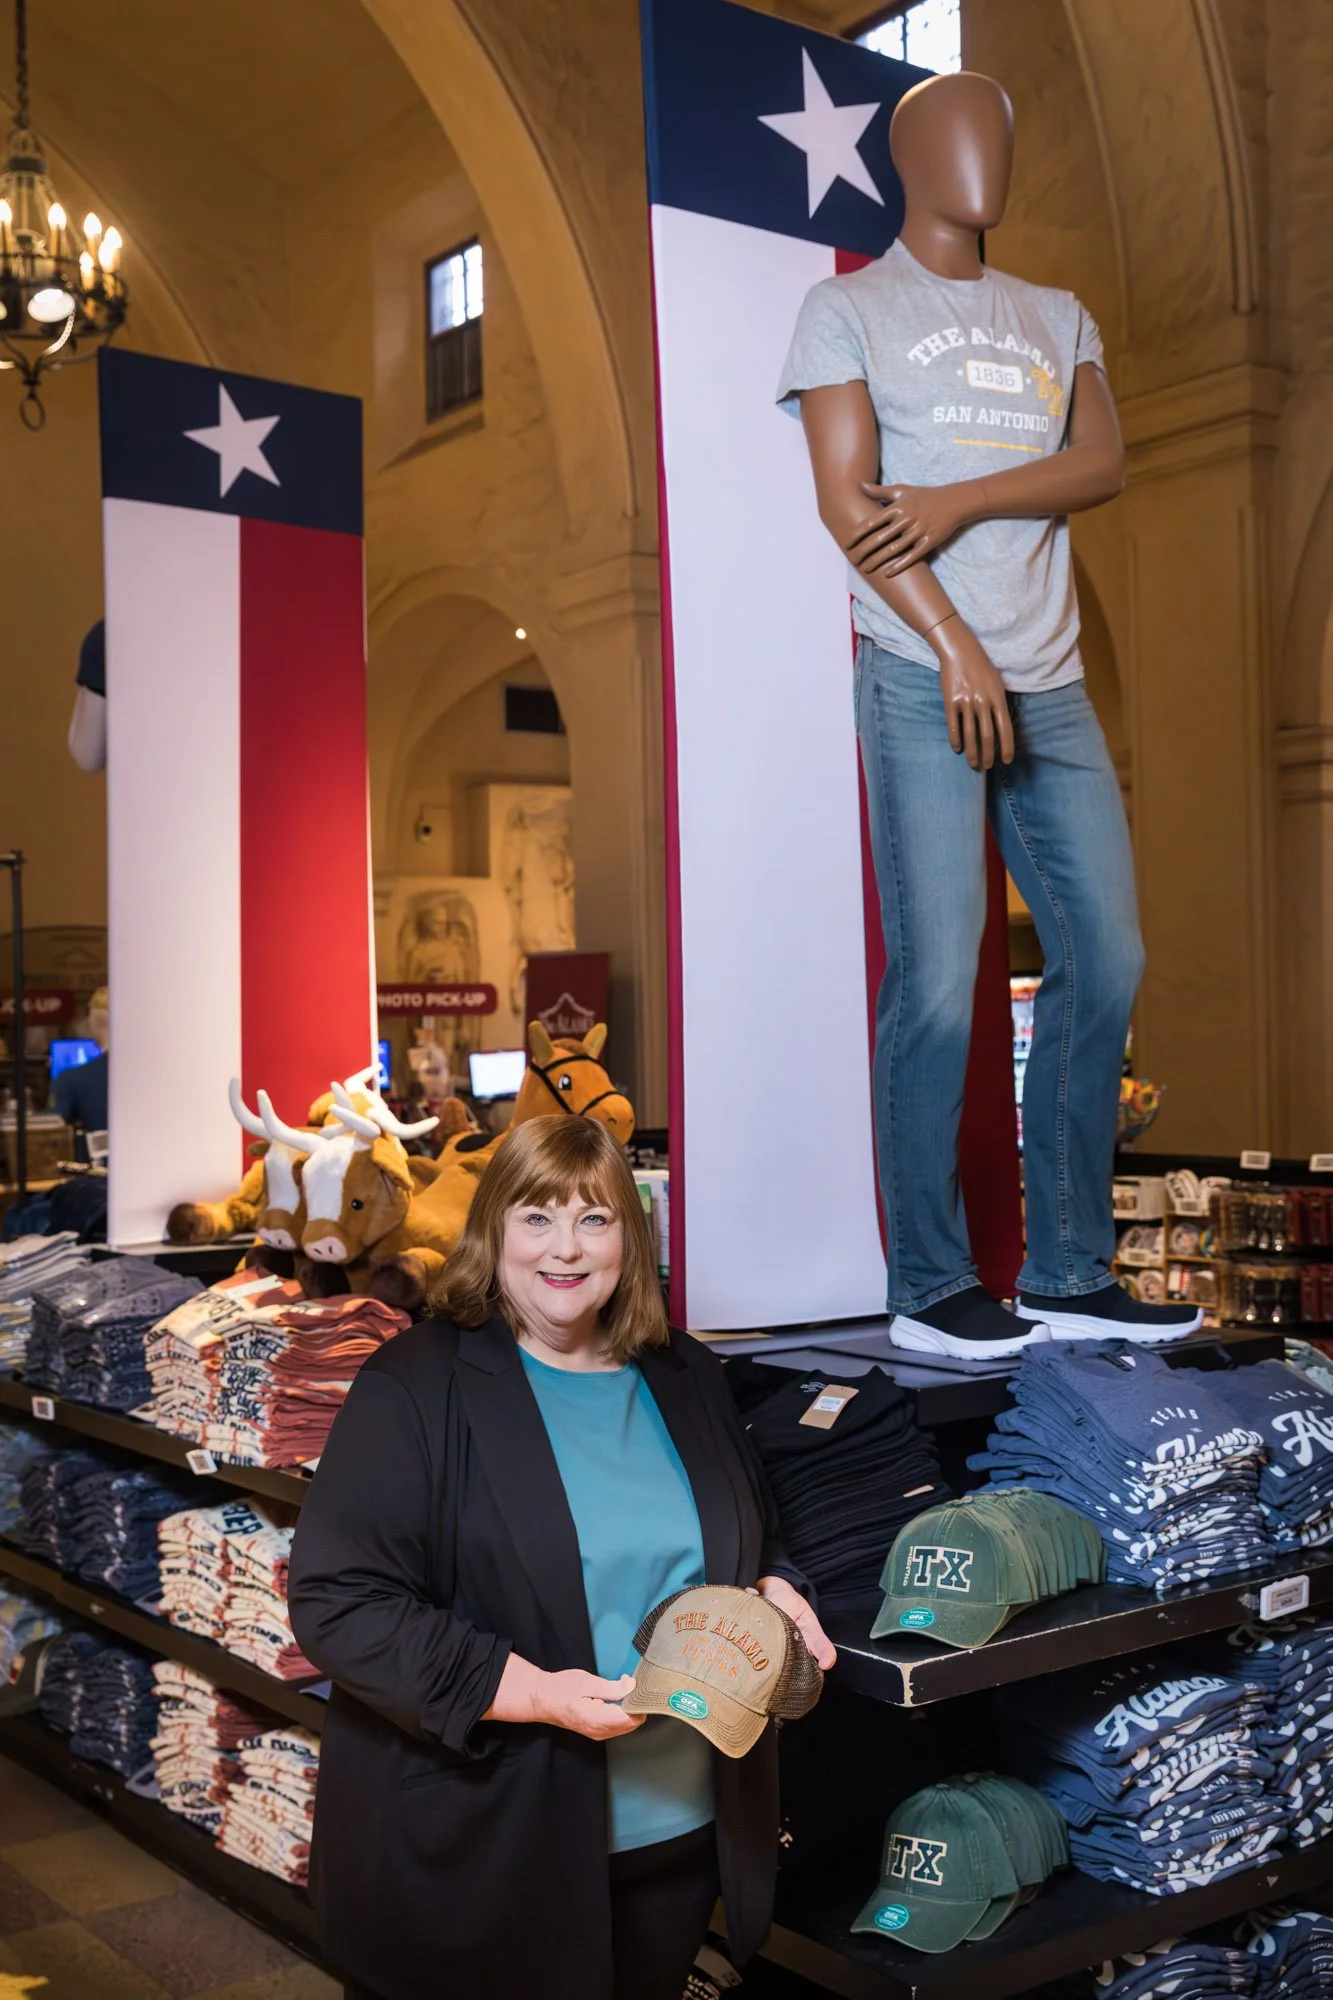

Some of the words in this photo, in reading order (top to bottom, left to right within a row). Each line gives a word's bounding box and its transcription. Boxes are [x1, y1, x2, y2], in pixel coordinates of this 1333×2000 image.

[907, 327, 966, 367] THE
[970, 327, 1056, 379] ALAMO
[973, 366, 1016, 388] 1836
[933, 406, 973, 424] SAN
[976, 407, 1049, 433] ANTONIO
[425, 992, 488, 1008] PICK-UP
[912, 1545, 974, 1593] TX
[674, 1611, 709, 1633] THE
[710, 1615, 770, 1671] ALAMO
[1094, 1675, 1228, 1748] Alamo
[891, 1833, 948, 1886] TX
